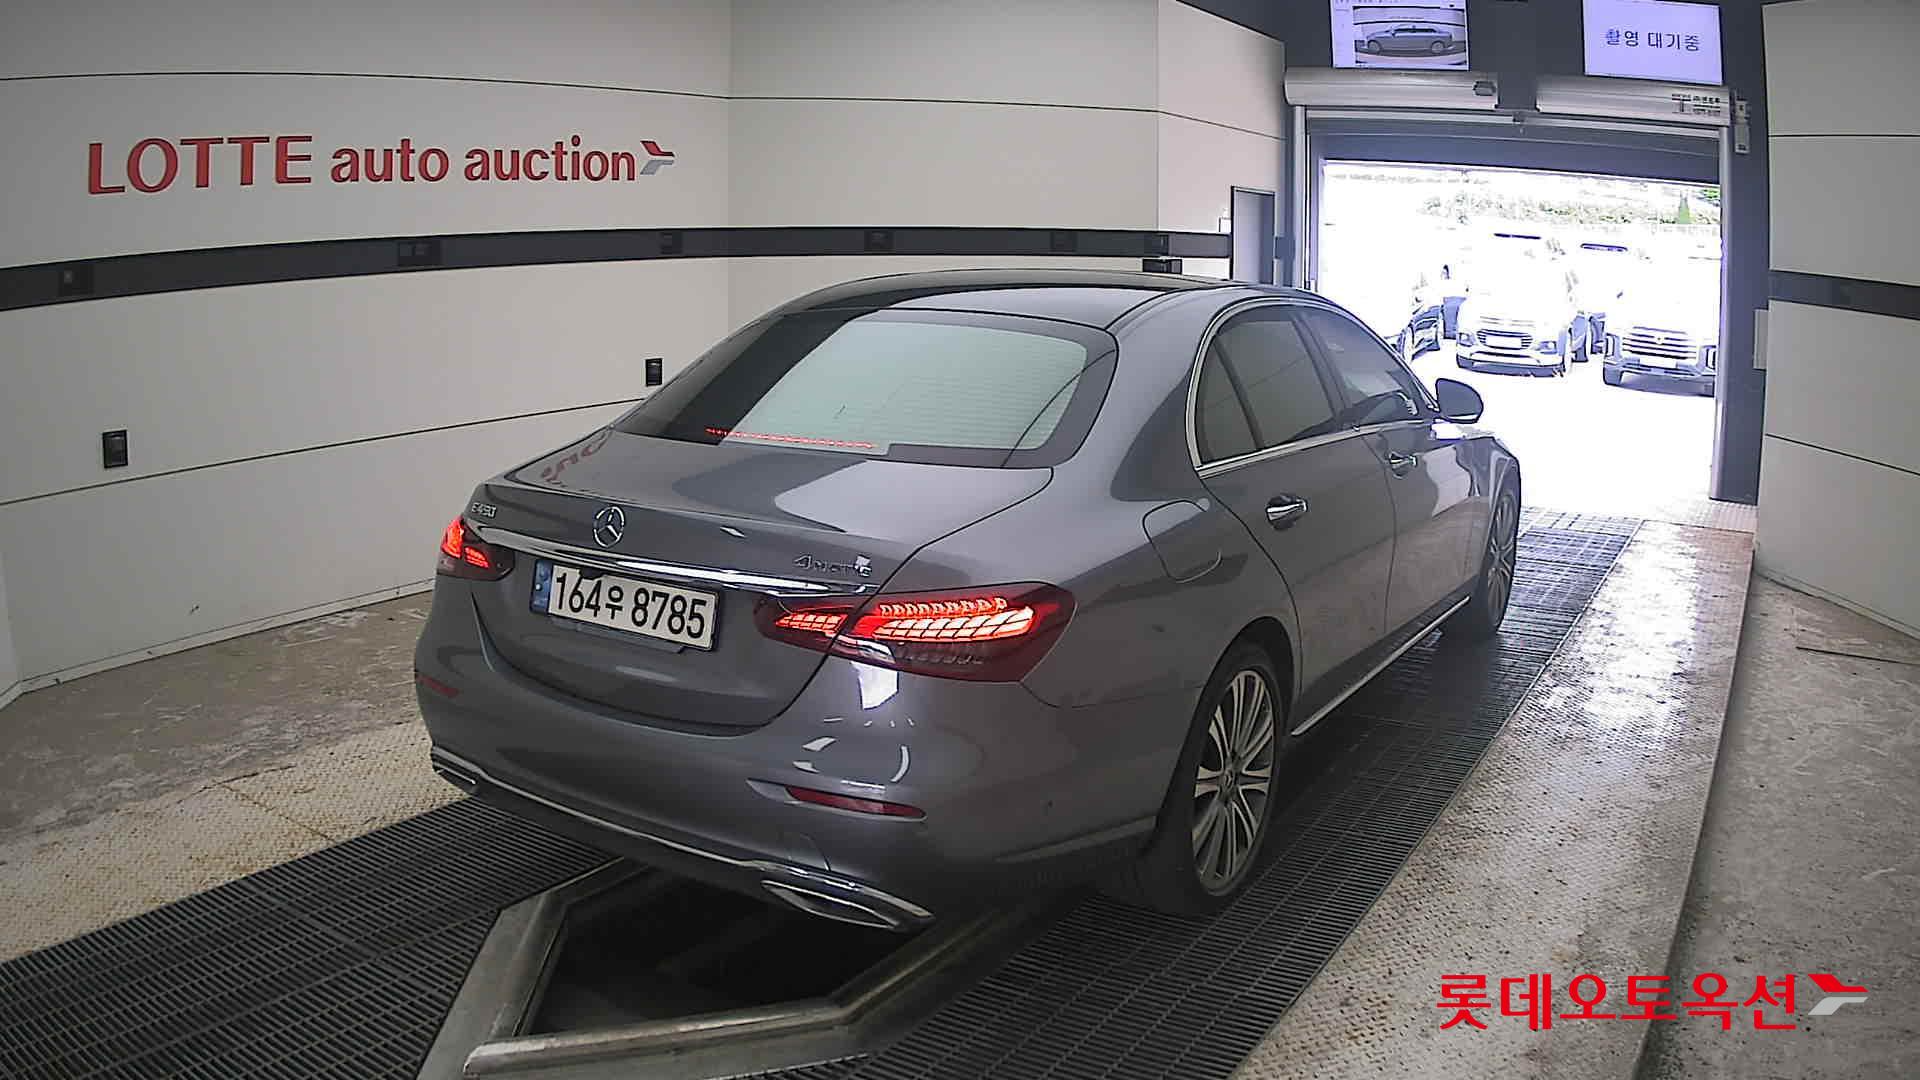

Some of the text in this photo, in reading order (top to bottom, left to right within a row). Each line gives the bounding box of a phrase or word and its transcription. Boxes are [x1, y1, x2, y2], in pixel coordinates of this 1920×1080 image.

[1646, 31, 1701, 52] 대기중
[88, 135, 637, 194] LOTTE auto auction
[556, 573, 707, 639] 164우 8785
